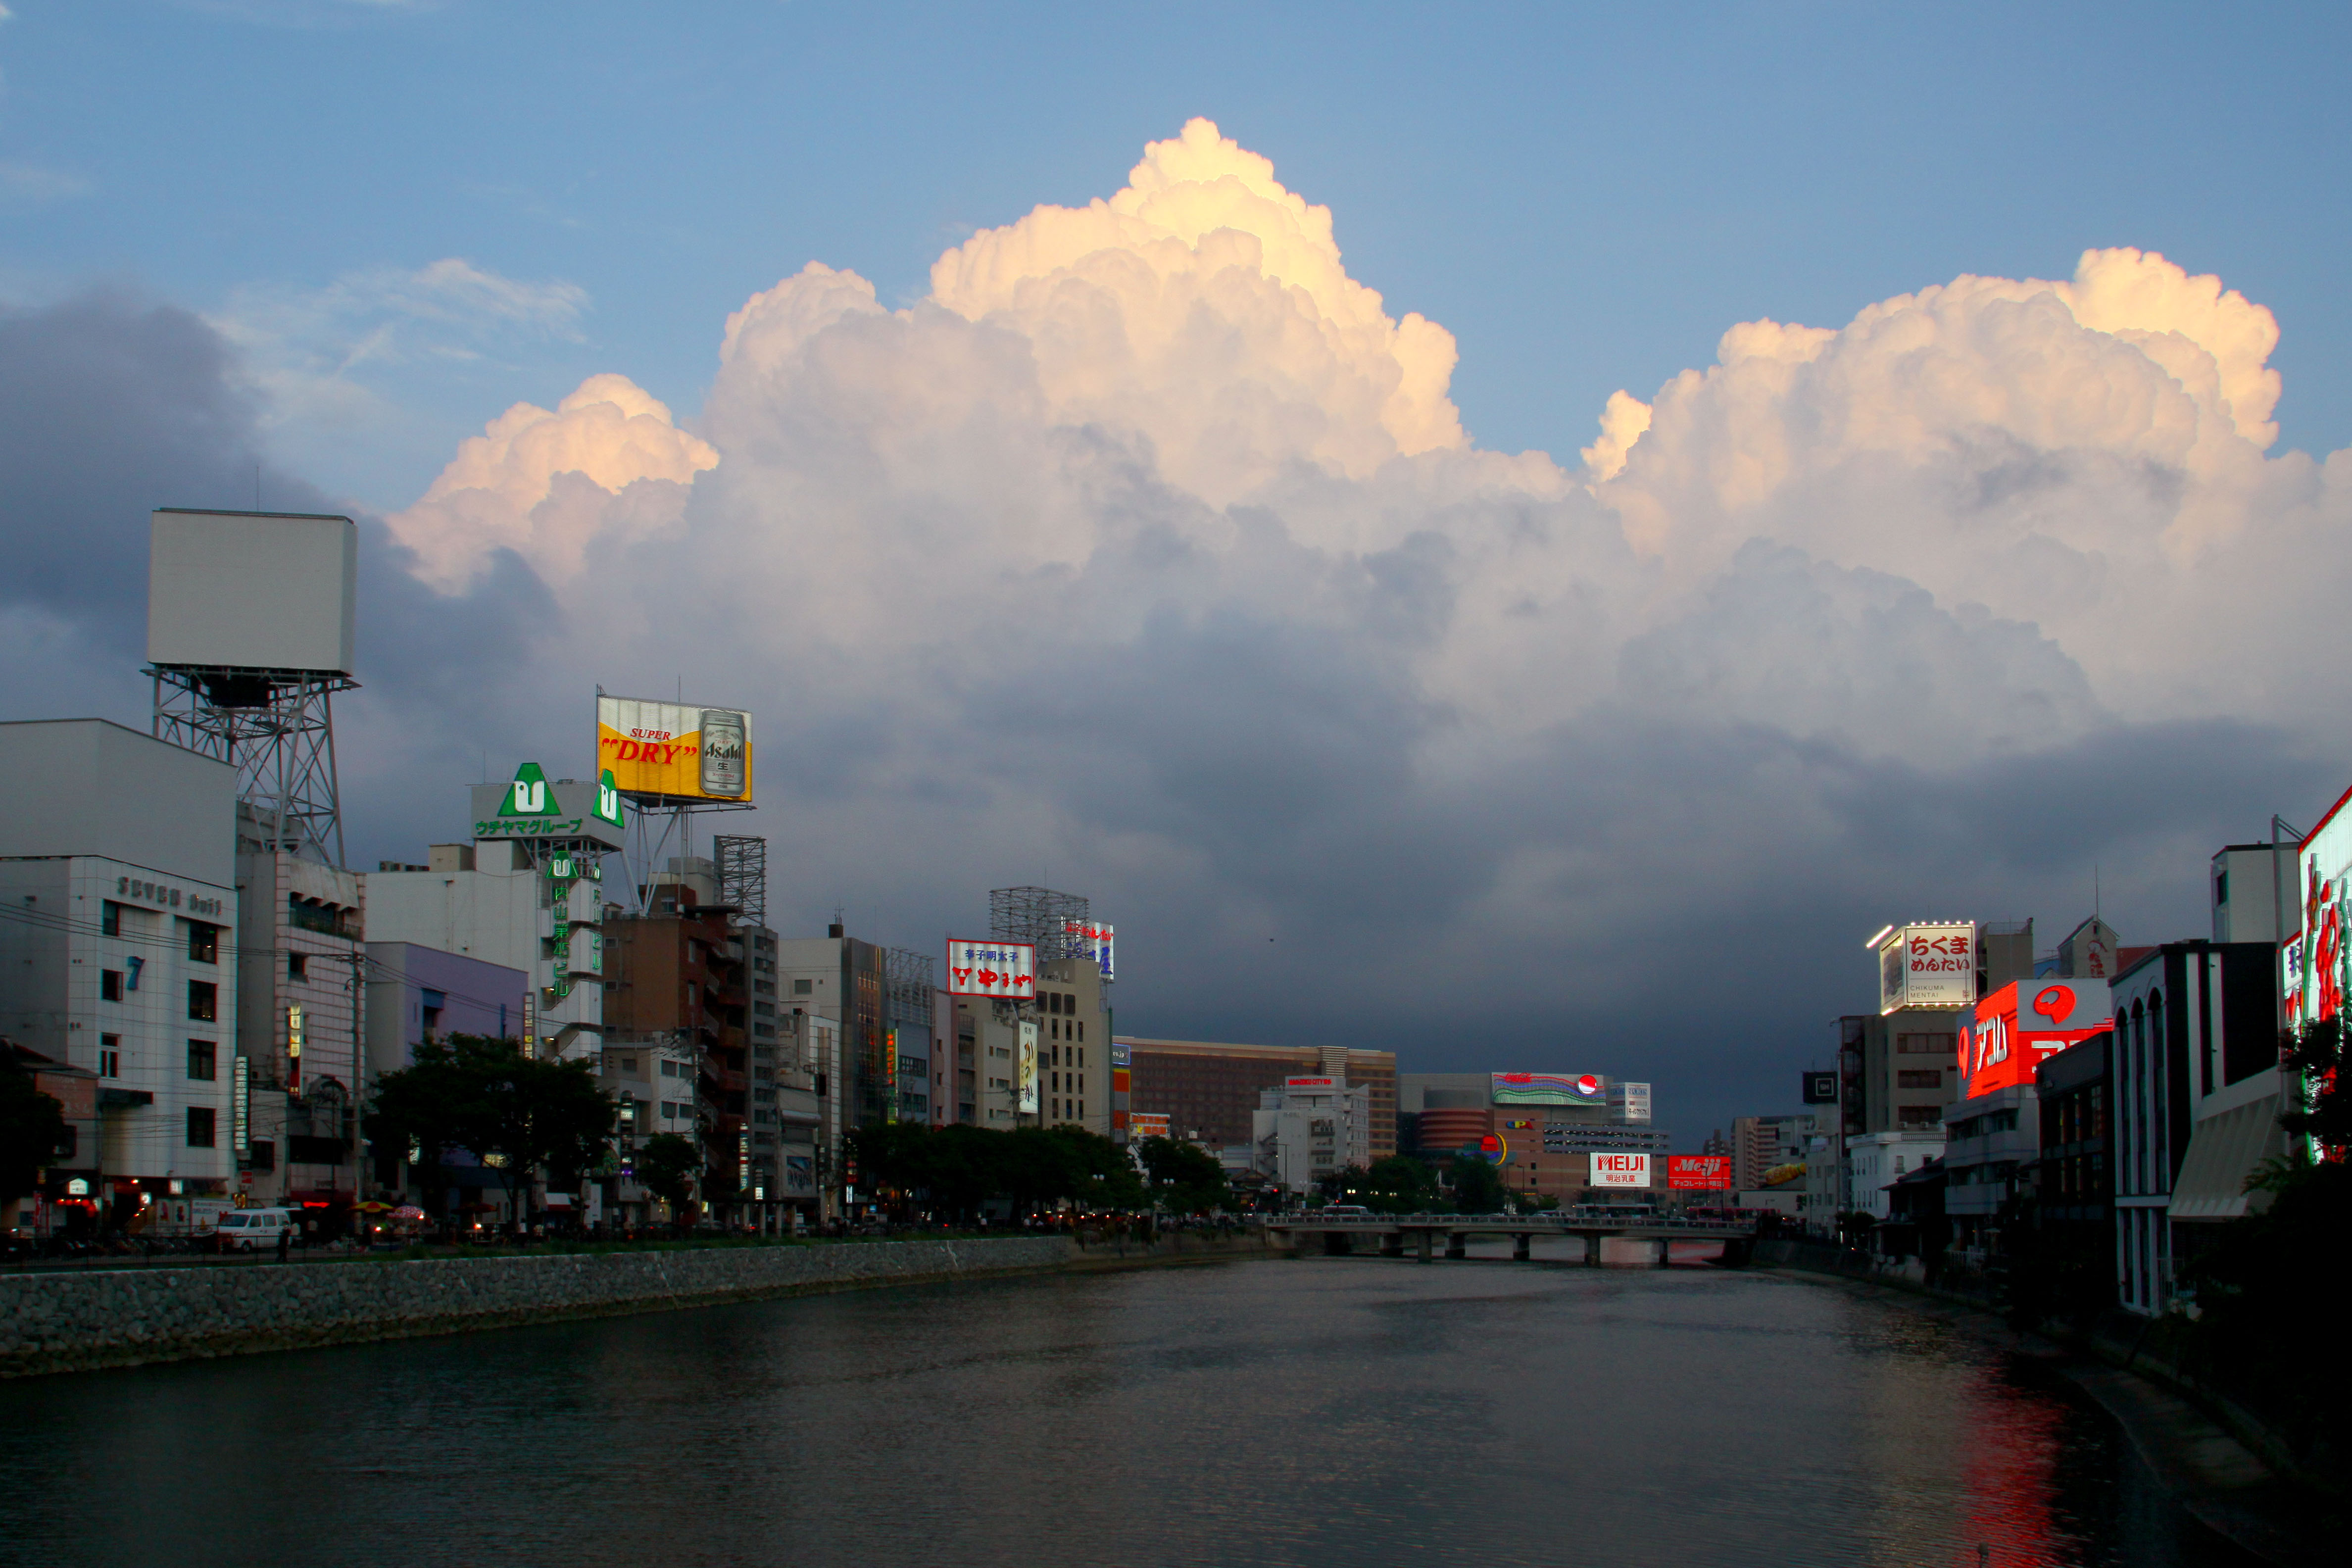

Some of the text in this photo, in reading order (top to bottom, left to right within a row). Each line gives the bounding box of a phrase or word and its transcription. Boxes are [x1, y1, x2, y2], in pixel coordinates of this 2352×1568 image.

[630, 728, 671, 740] SUPER
[705, 742, 741, 760] Asahi
[718, 761, 729, 771] 生
[475, 818, 583, 835] ウチヤマグループ
[118, 876, 181, 907] SEVEN
[553, 886, 570, 996] 内山第45ビル
[1909, 936, 1968, 956] ちくま
[965, 948, 1019, 963] 辛子明太子
[127, 956, 145, 990] 7
[1911, 958, 1970, 972] めんたい
[977, 967, 1032, 988] やまや
[1598, 1155, 1644, 1171] MEIJI
[1674, 1158, 1721, 1177] Meiji
[1606, 1175, 1636, 1183] 明治乳業
